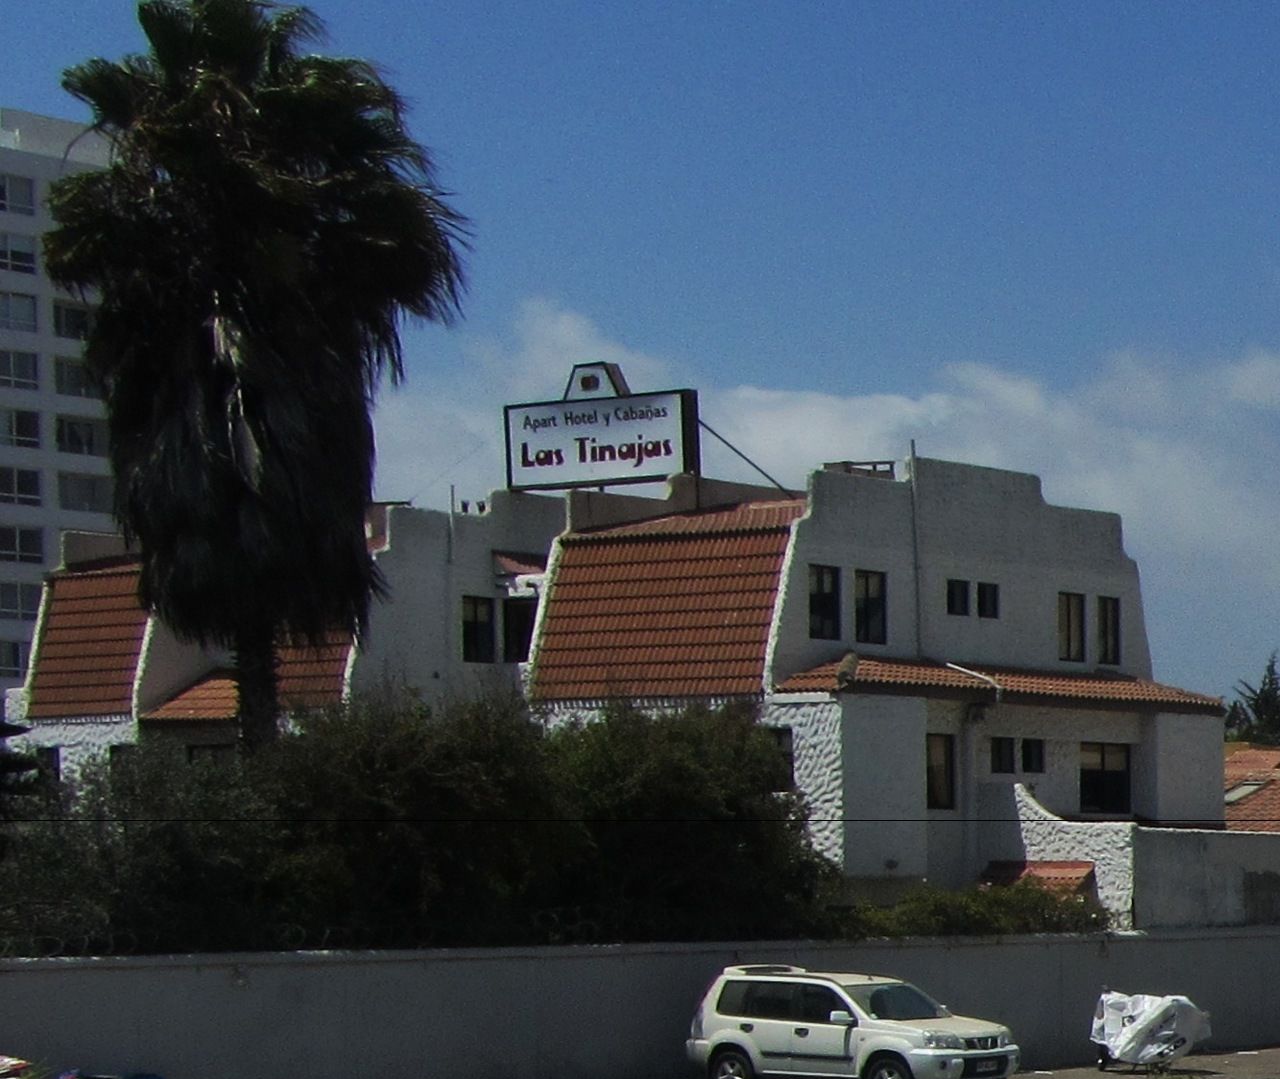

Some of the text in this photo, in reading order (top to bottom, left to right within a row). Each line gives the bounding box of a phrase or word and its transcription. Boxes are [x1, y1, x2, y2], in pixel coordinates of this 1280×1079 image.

[523, 405, 668, 433] Apart Hotel y Cabañas
[521, 434, 673, 467] Las Tinajas
